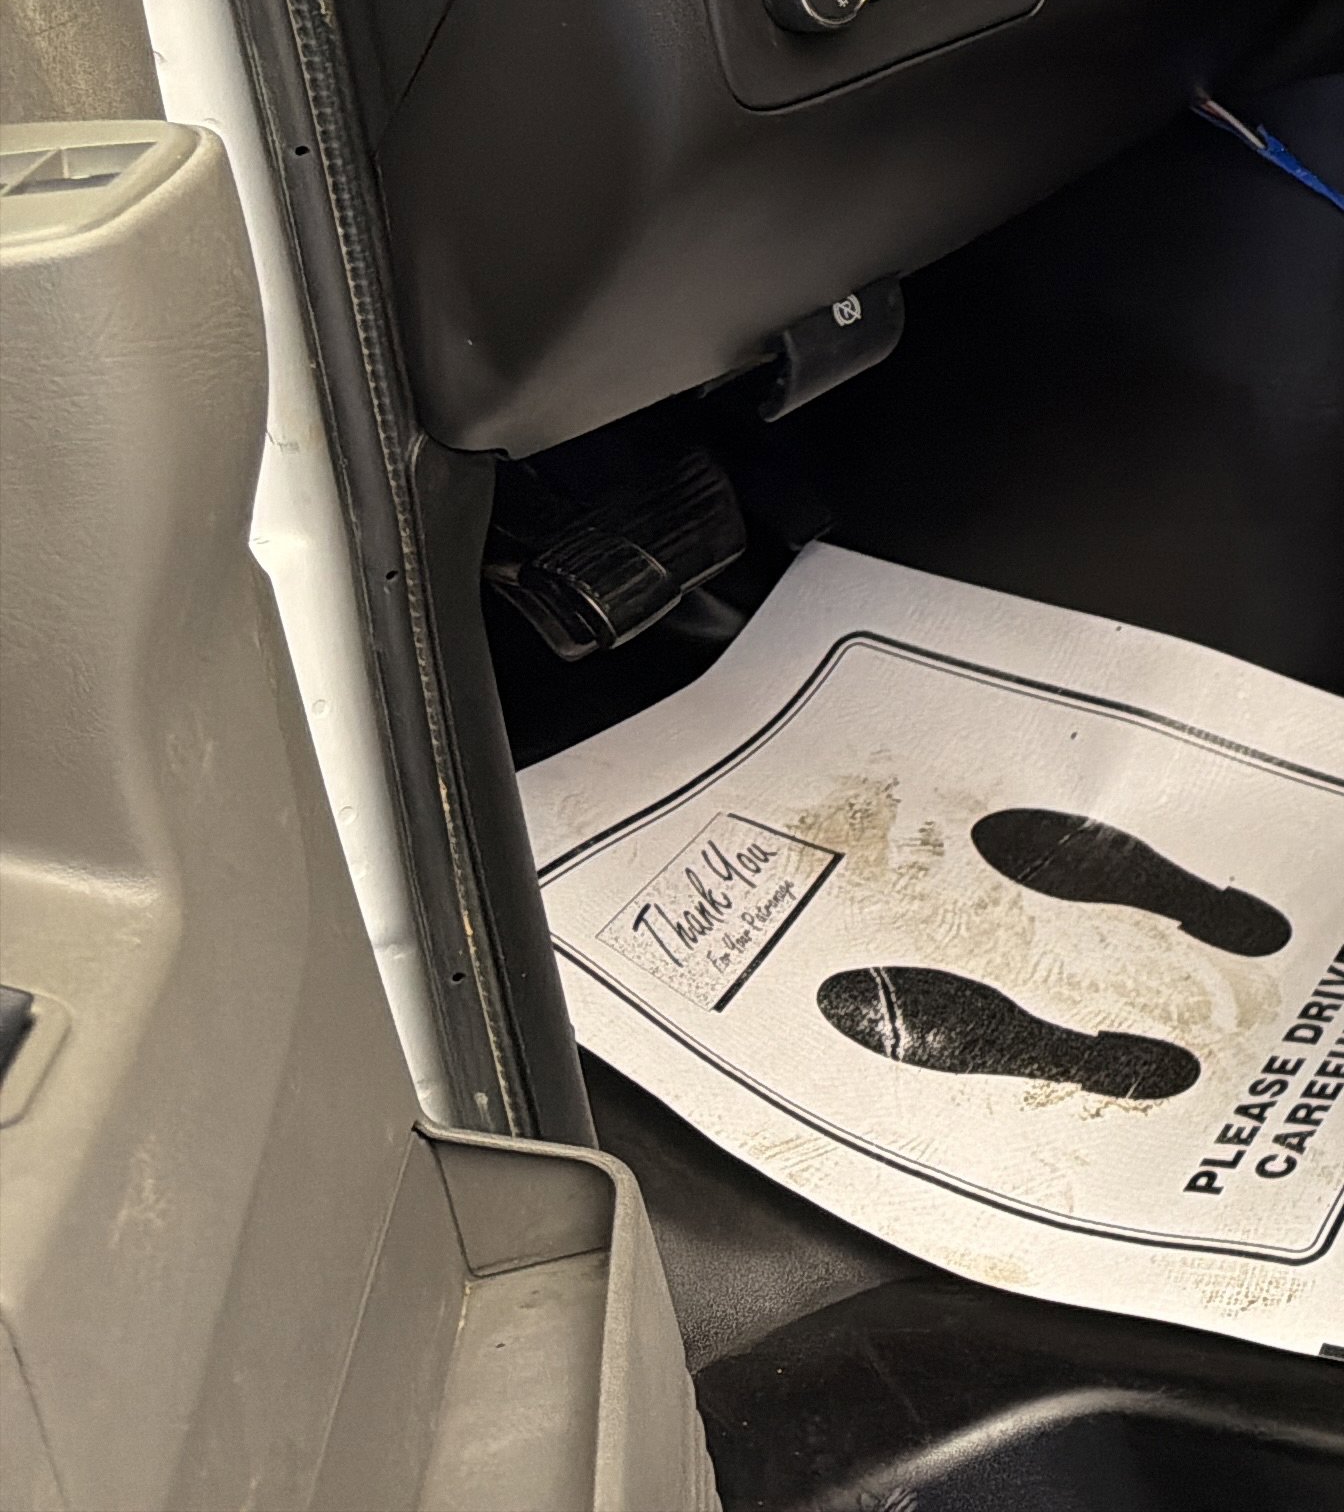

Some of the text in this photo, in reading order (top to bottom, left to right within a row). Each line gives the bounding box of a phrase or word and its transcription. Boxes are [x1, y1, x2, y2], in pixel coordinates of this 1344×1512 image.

[632, 839, 778, 968] Thank You
[1182, 1055, 1307, 1195] PLEASE
